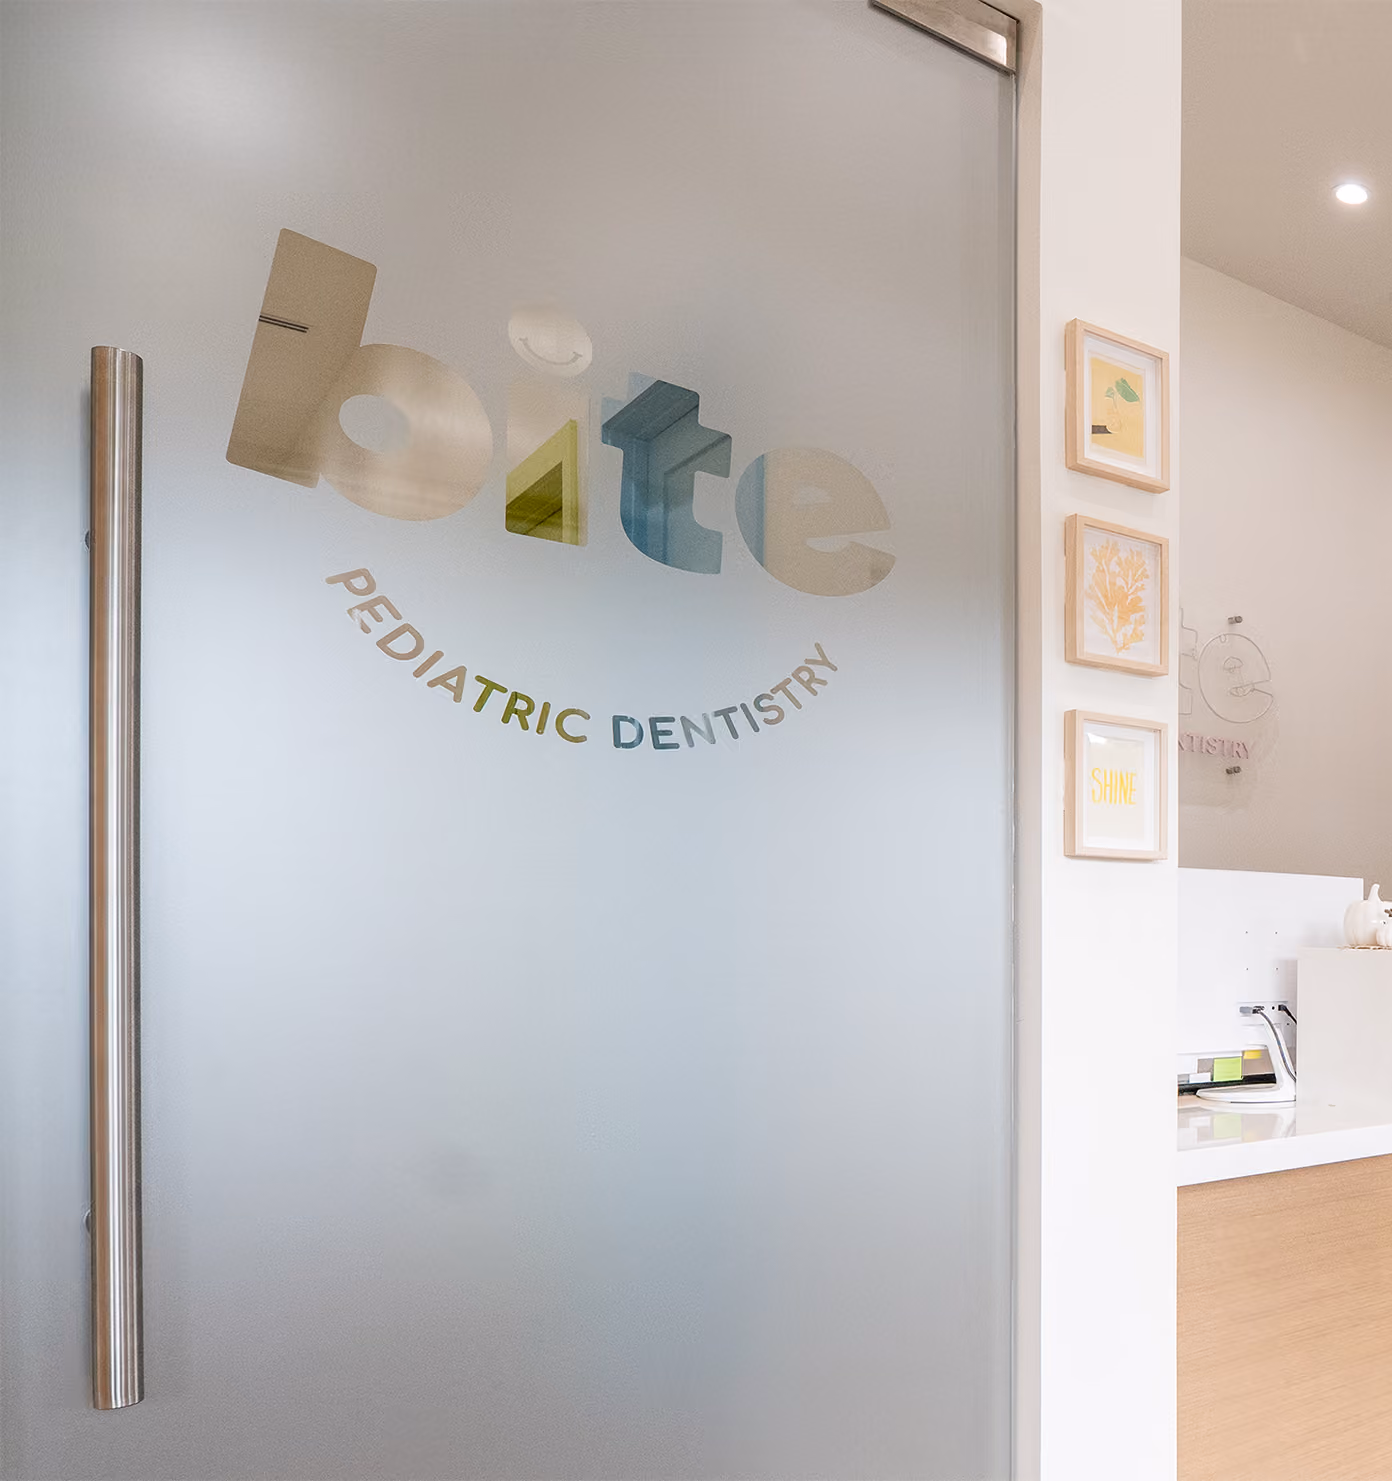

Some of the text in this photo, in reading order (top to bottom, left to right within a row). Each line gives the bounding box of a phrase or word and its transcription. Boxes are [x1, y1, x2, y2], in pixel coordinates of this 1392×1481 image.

[226, 228, 897, 597] bite
[325, 567, 838, 750] PEDIATRIC DENTISTRY
[1091, 767, 1137, 805] SHINE
